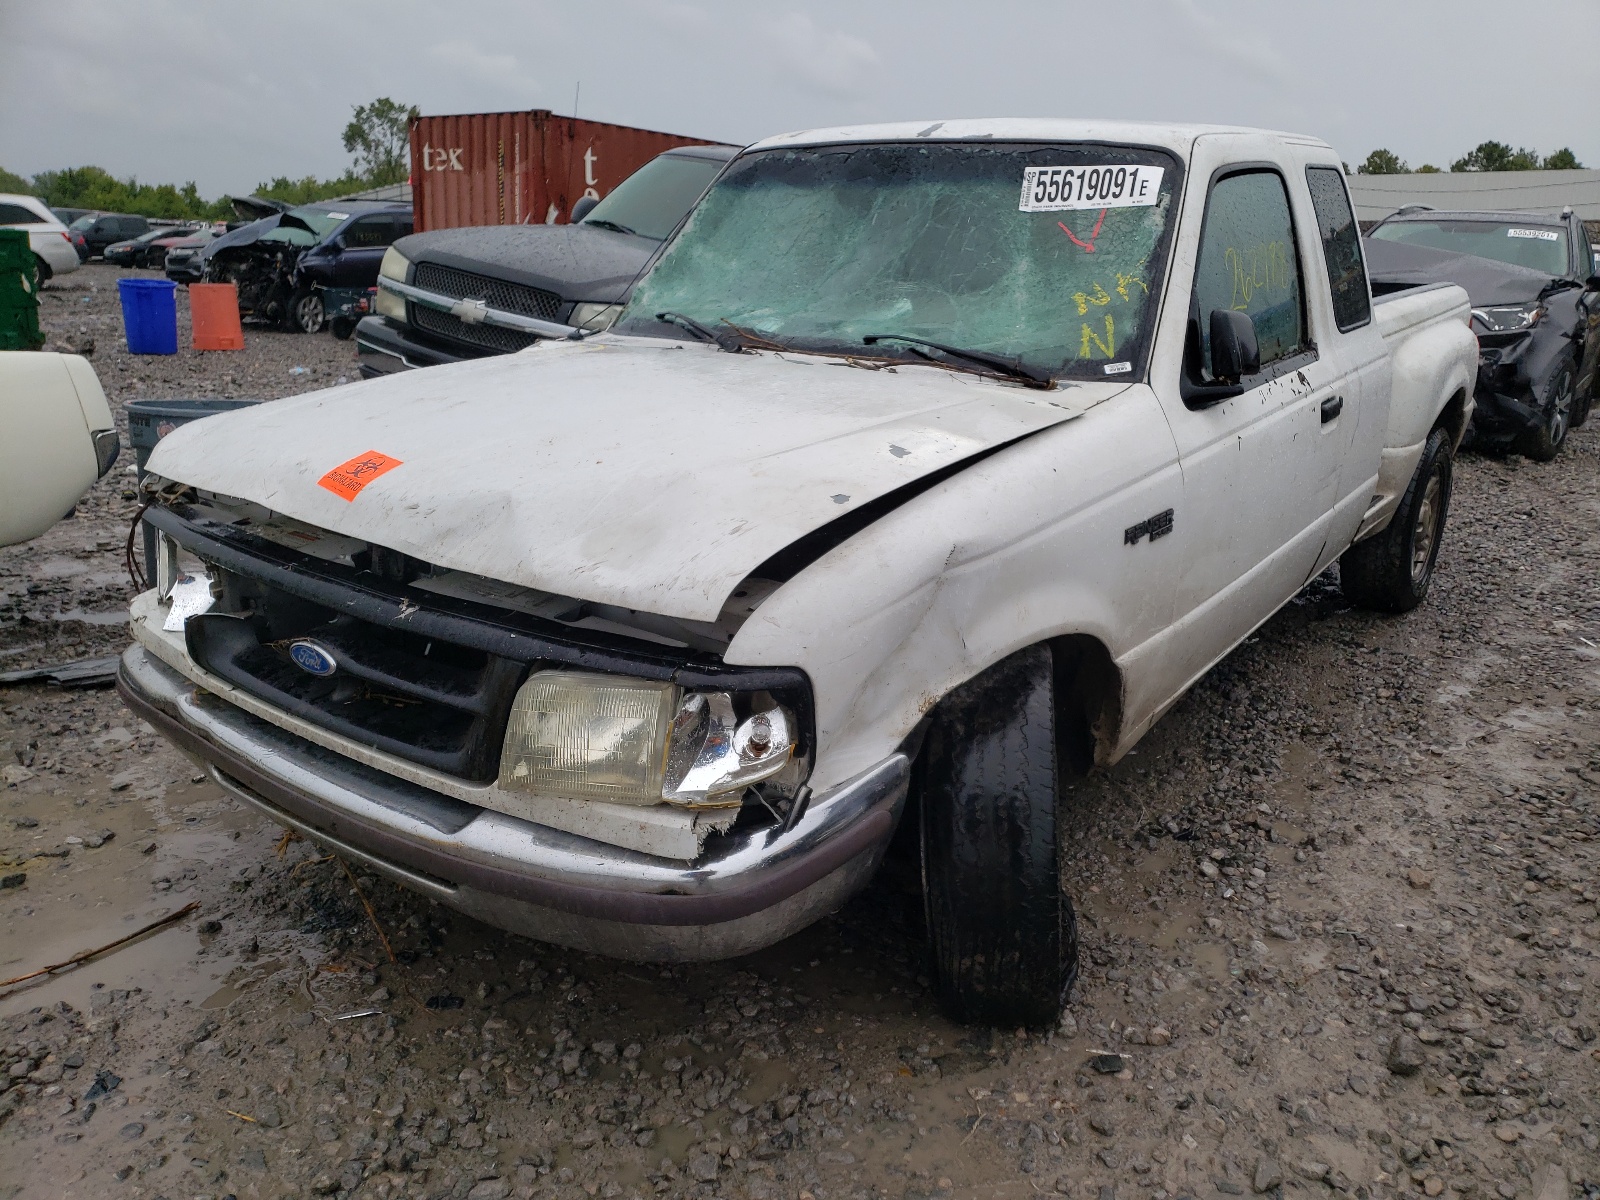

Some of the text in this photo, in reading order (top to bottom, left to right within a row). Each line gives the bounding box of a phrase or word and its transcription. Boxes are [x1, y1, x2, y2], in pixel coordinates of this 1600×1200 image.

[422, 141, 465, 172] tex
[1034, 167, 1140, 203] 55619091
[1139, 179, 1149, 197] E
[298, 648, 322, 670] Ford
